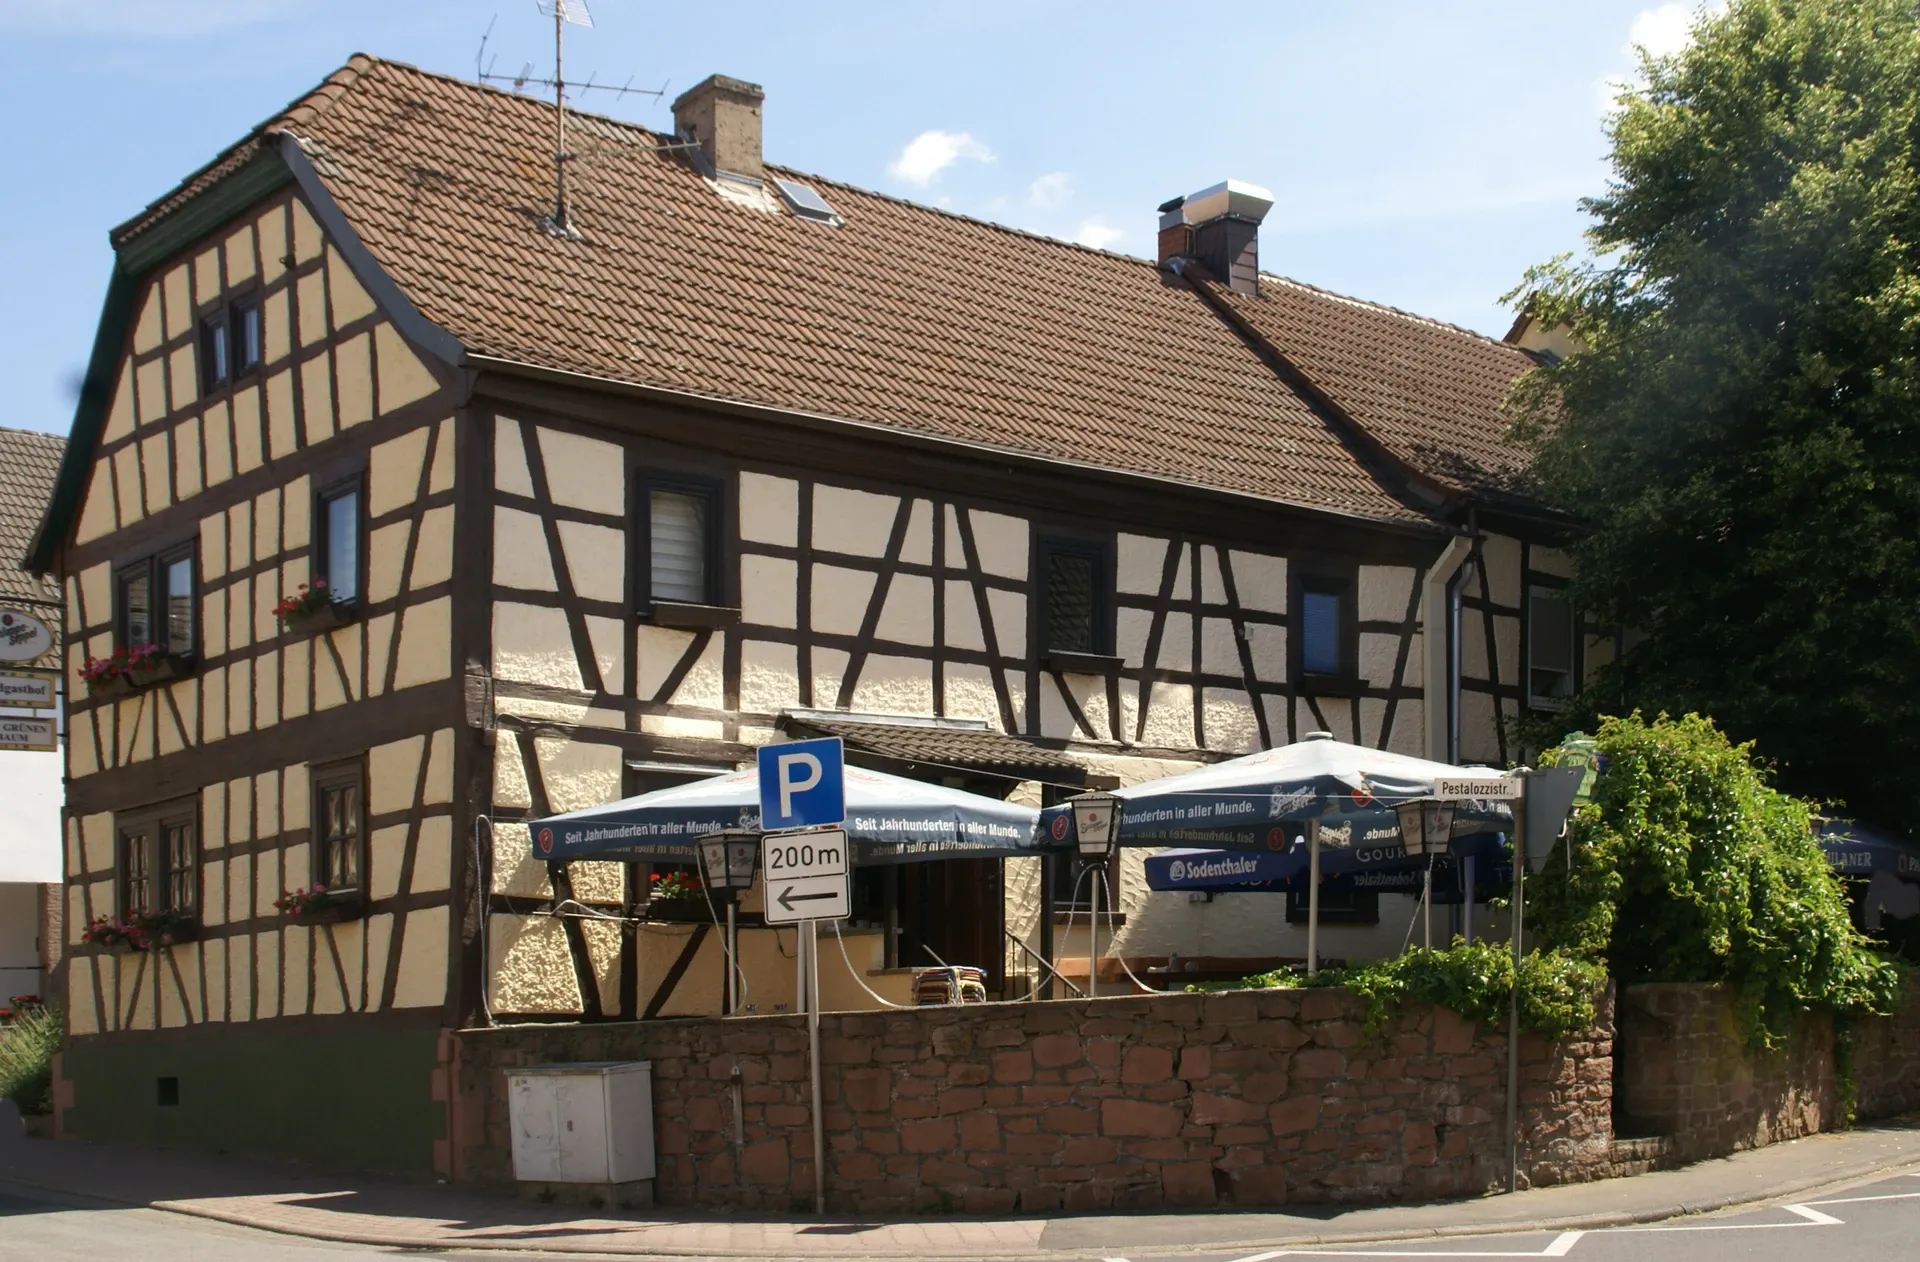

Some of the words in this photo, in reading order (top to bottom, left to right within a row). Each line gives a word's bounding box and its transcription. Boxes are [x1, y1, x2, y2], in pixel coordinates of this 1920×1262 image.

[778, 752, 823, 818] P
[1442, 782, 1509, 795] Pestalozzistr.
[1175, 807, 1185, 819] in
[1187, 805, 1213, 819] aller
[1215, 801, 1255, 817] Munde.
[565, 829, 582, 844] Seit
[584, 823, 649, 841] Jahrhunderten
[649, 822, 660, 835] in
[661, 821, 684, 836] aller
[686, 819, 721, 834] Munde
[855, 818, 877, 831] Seit
[880, 818, 954, 833] Jahrhunderten
[967, 821, 987, 834] aller
[989, 823, 1021, 838] Munde.
[1187, 857, 1258, 879] Sodenthaler
